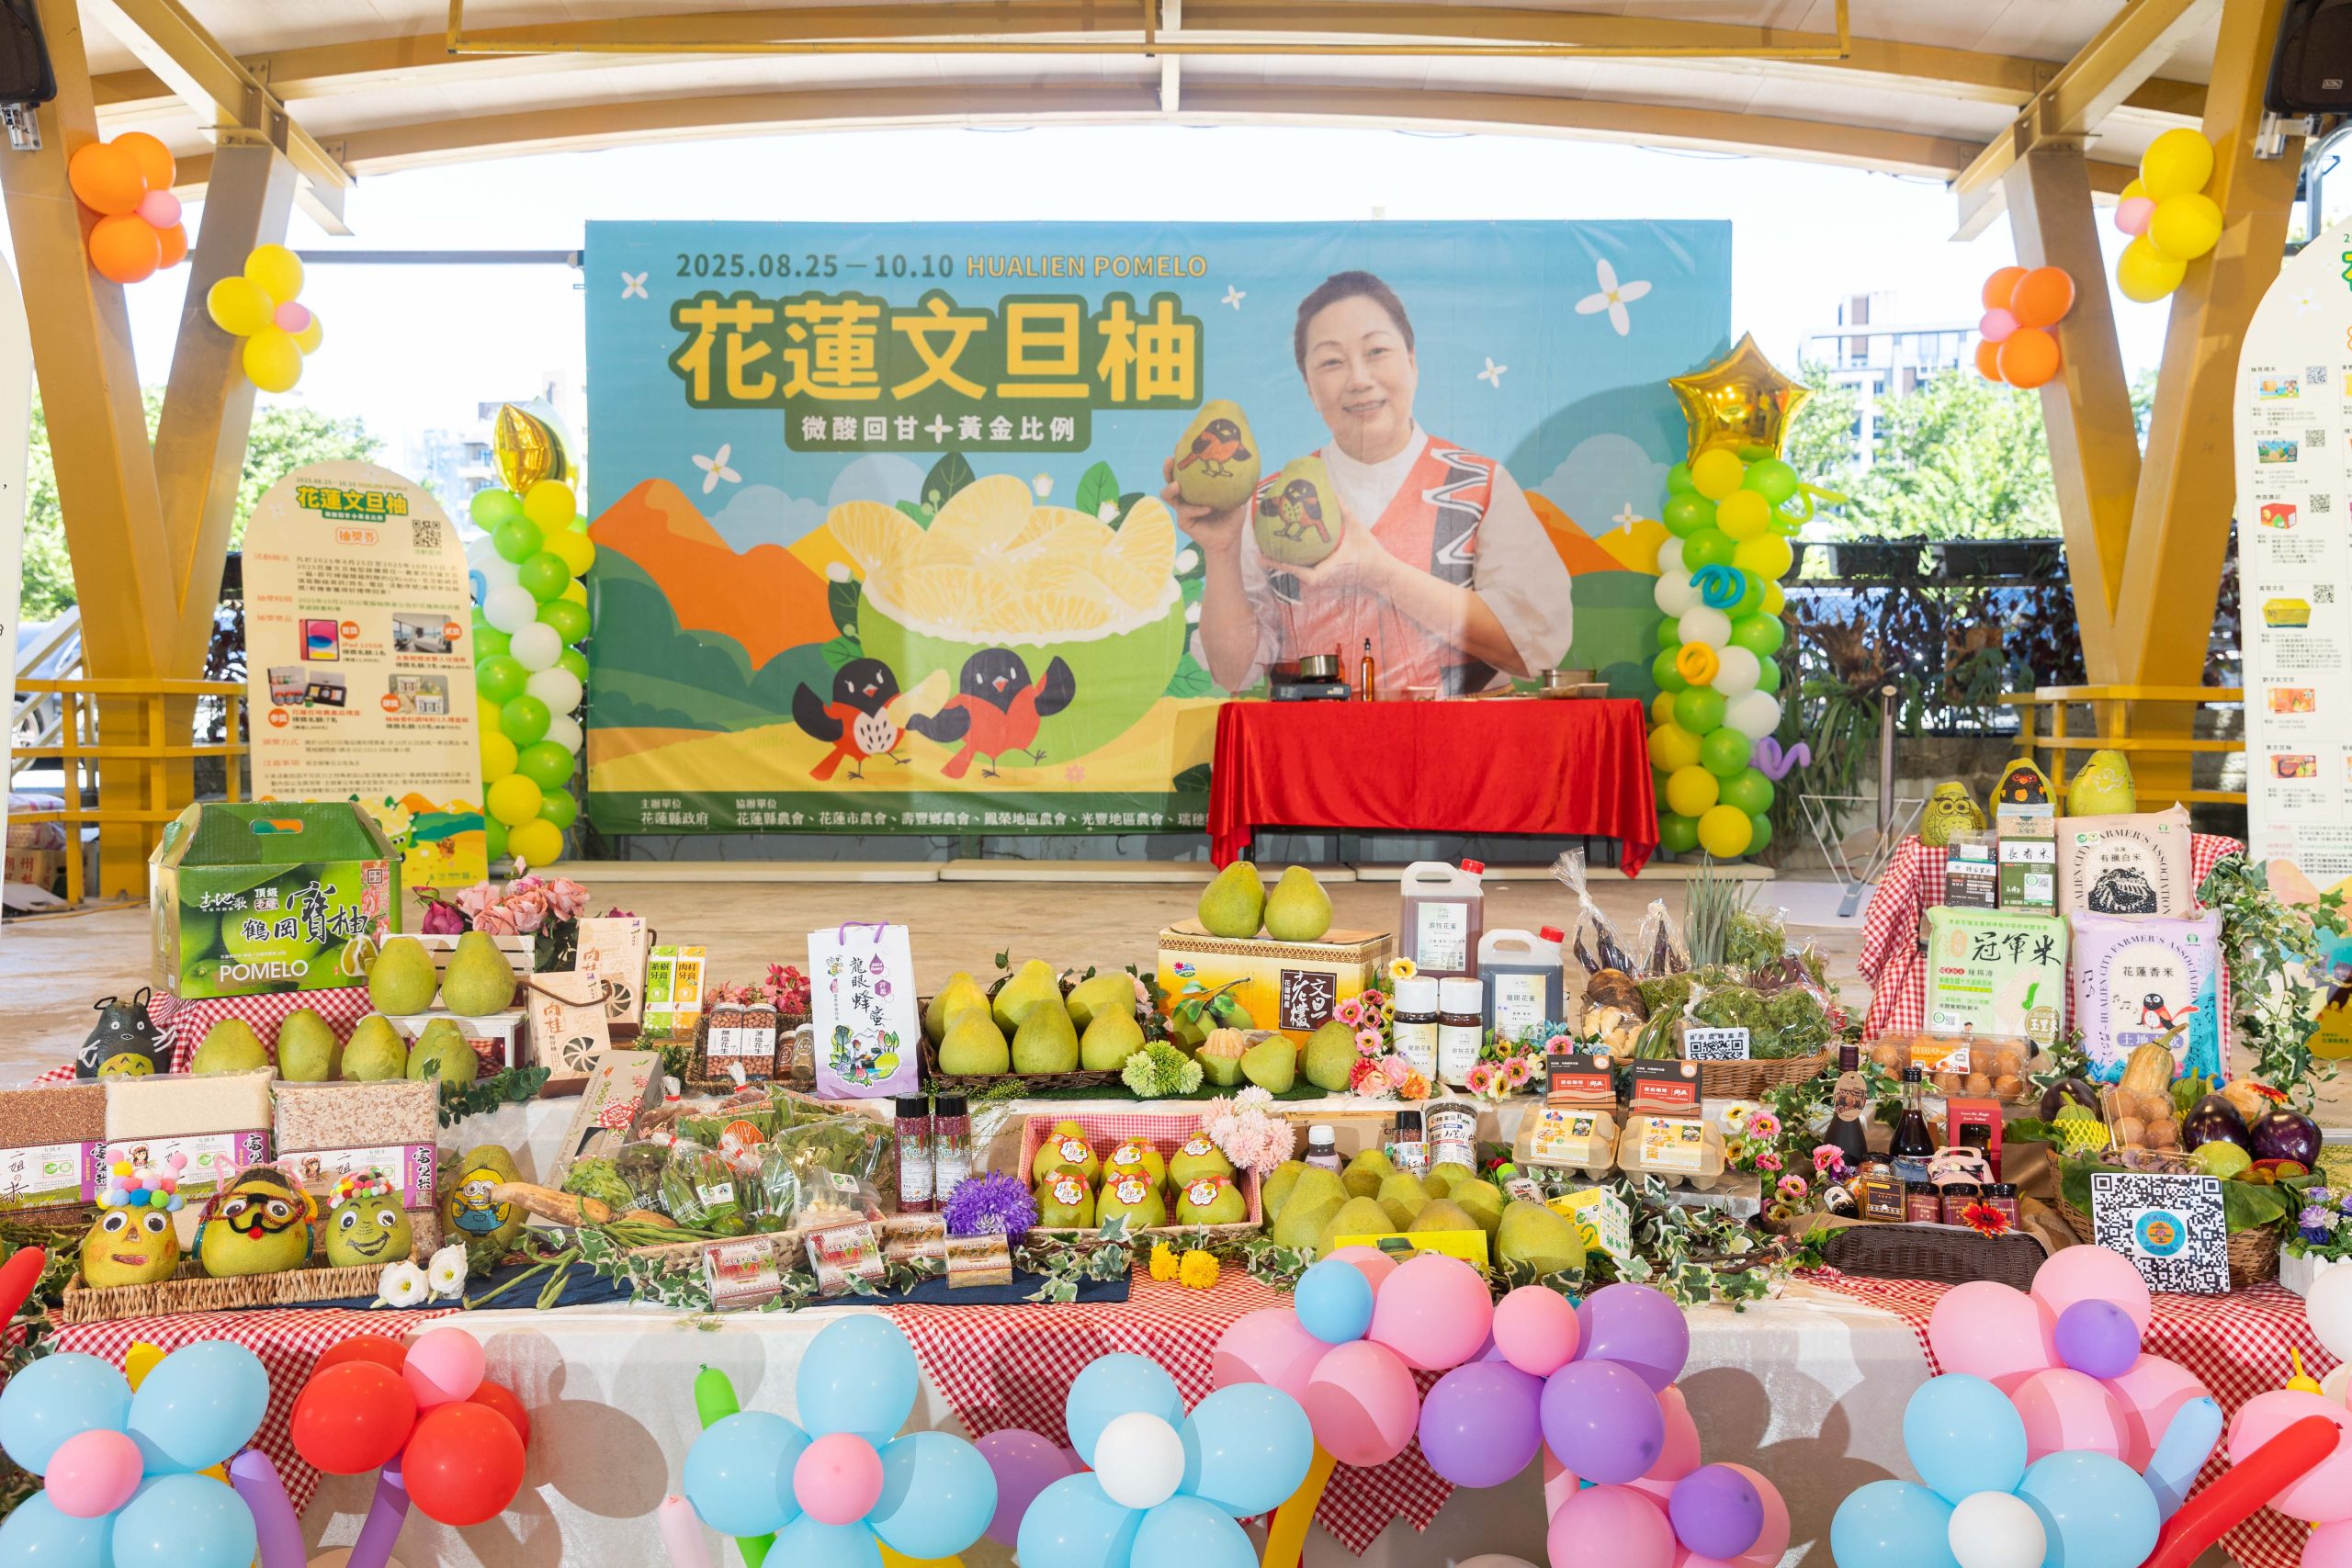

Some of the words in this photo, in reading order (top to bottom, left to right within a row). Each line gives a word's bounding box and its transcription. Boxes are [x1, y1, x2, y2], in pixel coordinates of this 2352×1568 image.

[967, 254, 1085, 277] HUALIEN
[1093, 254, 1207, 278] POMELO
[677, 297, 1195, 402] 花蓮文旦柚
[296, 486, 408, 514] 花蓮文旦柚
[641, 811, 709, 825] 花蓮縣政府
[254, 886, 279, 897] 頂級
[2110, 934, 2165, 953] FARMER'S
[220, 960, 309, 982] POMELO
[2100, 954, 2113, 976] CITY
[2122, 966, 2174, 977] 花蓮香米
[2169, 942, 2199, 1005] ASSOCIATION
[849, 956, 893, 1028] 龍眼蜂蜜
[1308, 978, 1333, 1020] 文旦
[2099, 979, 2109, 1023] HUALIEN
